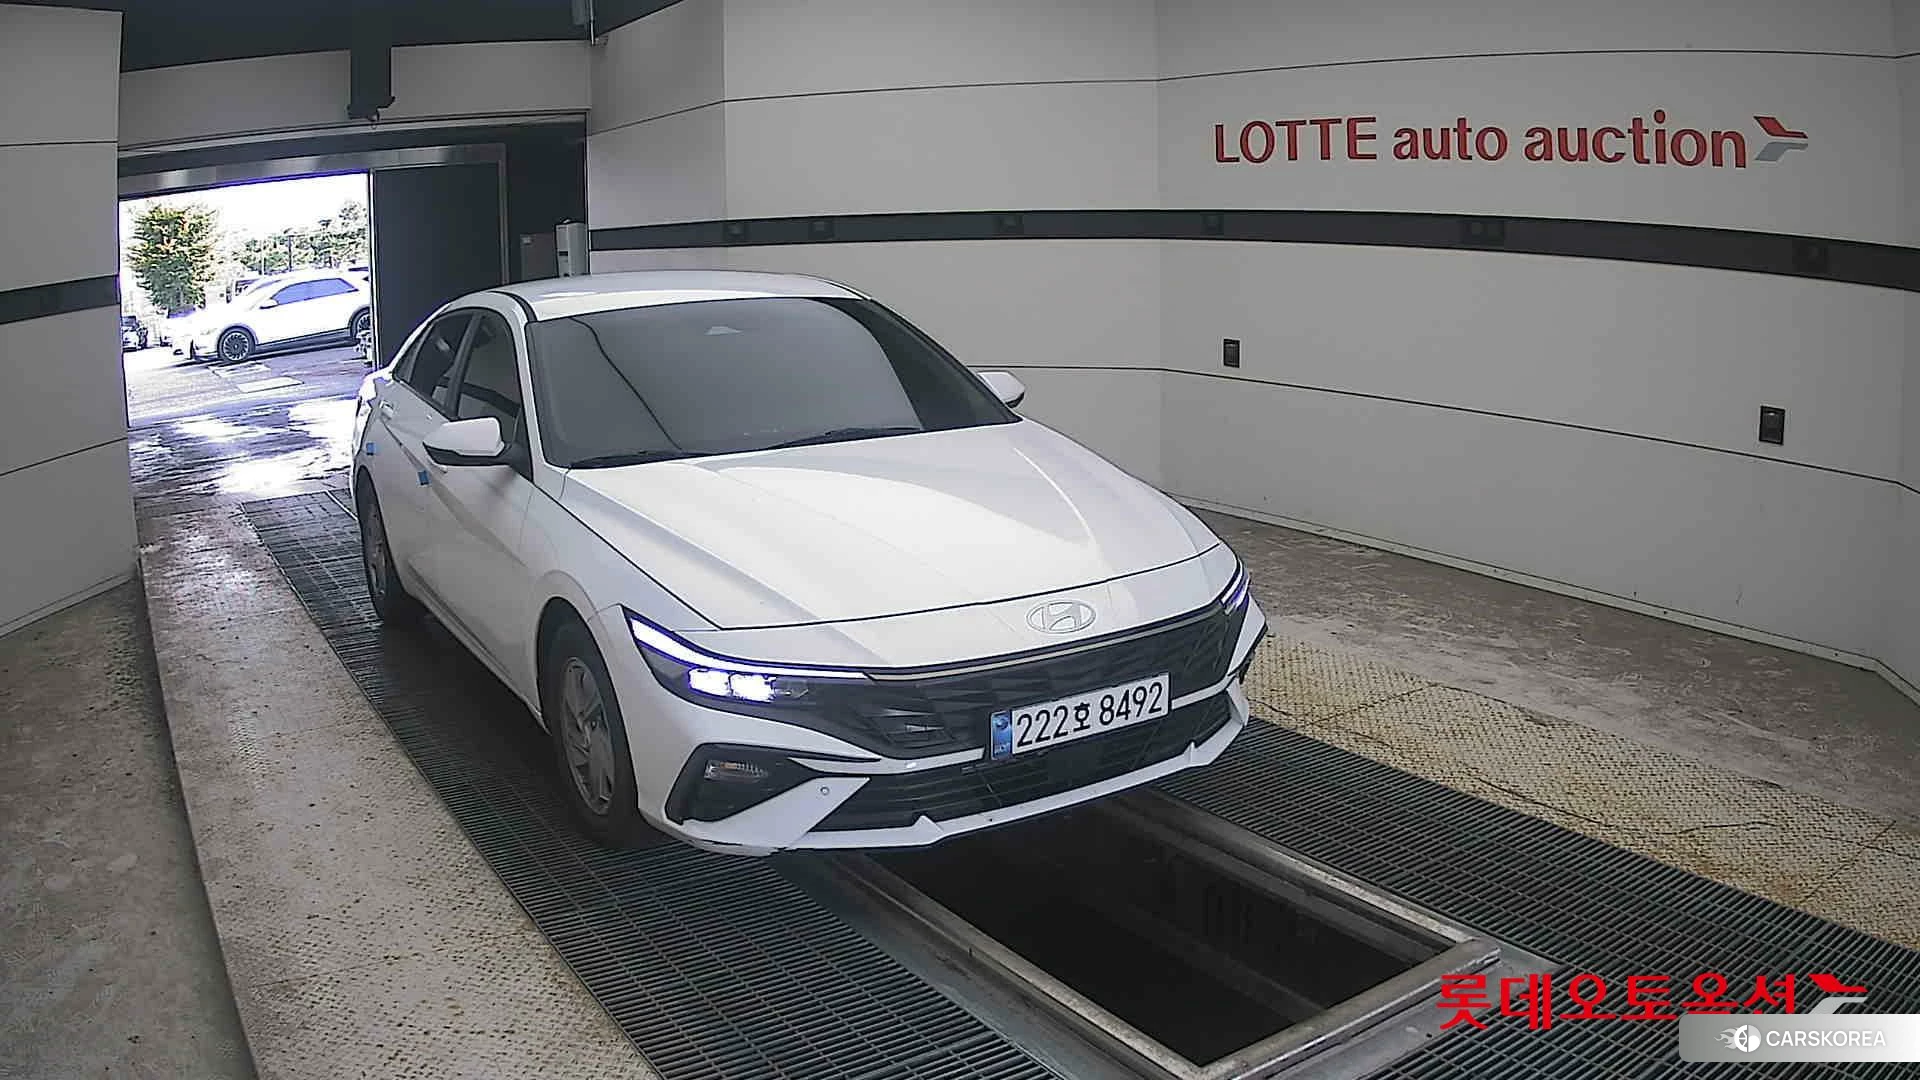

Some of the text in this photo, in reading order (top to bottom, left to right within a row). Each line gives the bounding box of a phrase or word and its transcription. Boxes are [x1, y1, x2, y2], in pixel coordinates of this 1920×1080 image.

[1215, 109, 1747, 169] LOTTE auto auction
[1017, 682, 1162, 747] 222호 8492
